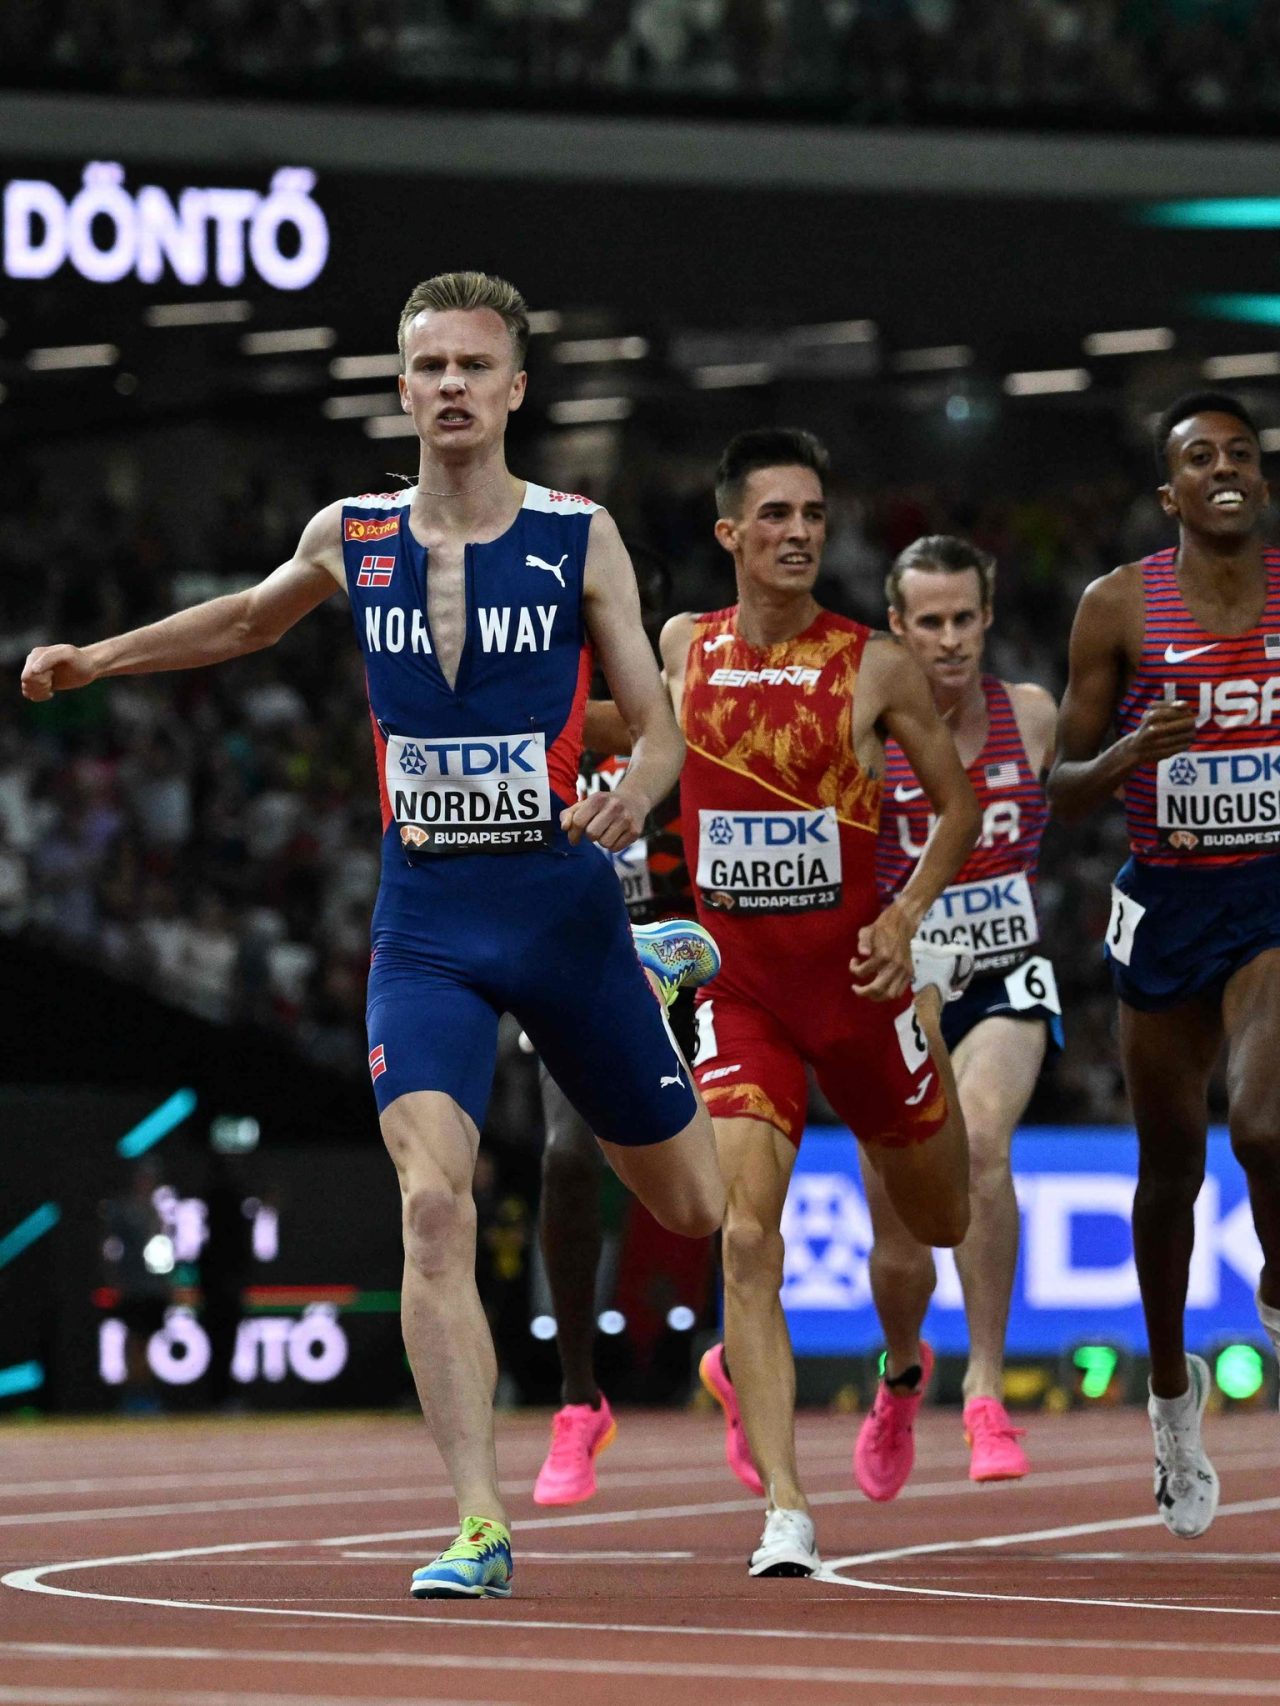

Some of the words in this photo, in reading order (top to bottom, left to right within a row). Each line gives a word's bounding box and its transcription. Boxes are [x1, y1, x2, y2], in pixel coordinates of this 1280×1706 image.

[367, 521, 398, 535] EXTRA
[425, 739, 536, 775] TDK
[395, 781, 540, 822] NORDÅS
[434, 831, 521, 845] BUDAPEST
[524, 830, 543, 843] 23
[733, 814, 829, 845] TDK
[1203, 830, 1280, 845] BUDAPEST
[710, 854, 828, 888] GARCÍA
[739, 894, 816, 908] BUDAPEST
[818, 892, 835, 904] 23
[942, 880, 1020, 918] TDK
[1025, 965, 1046, 999] 6
